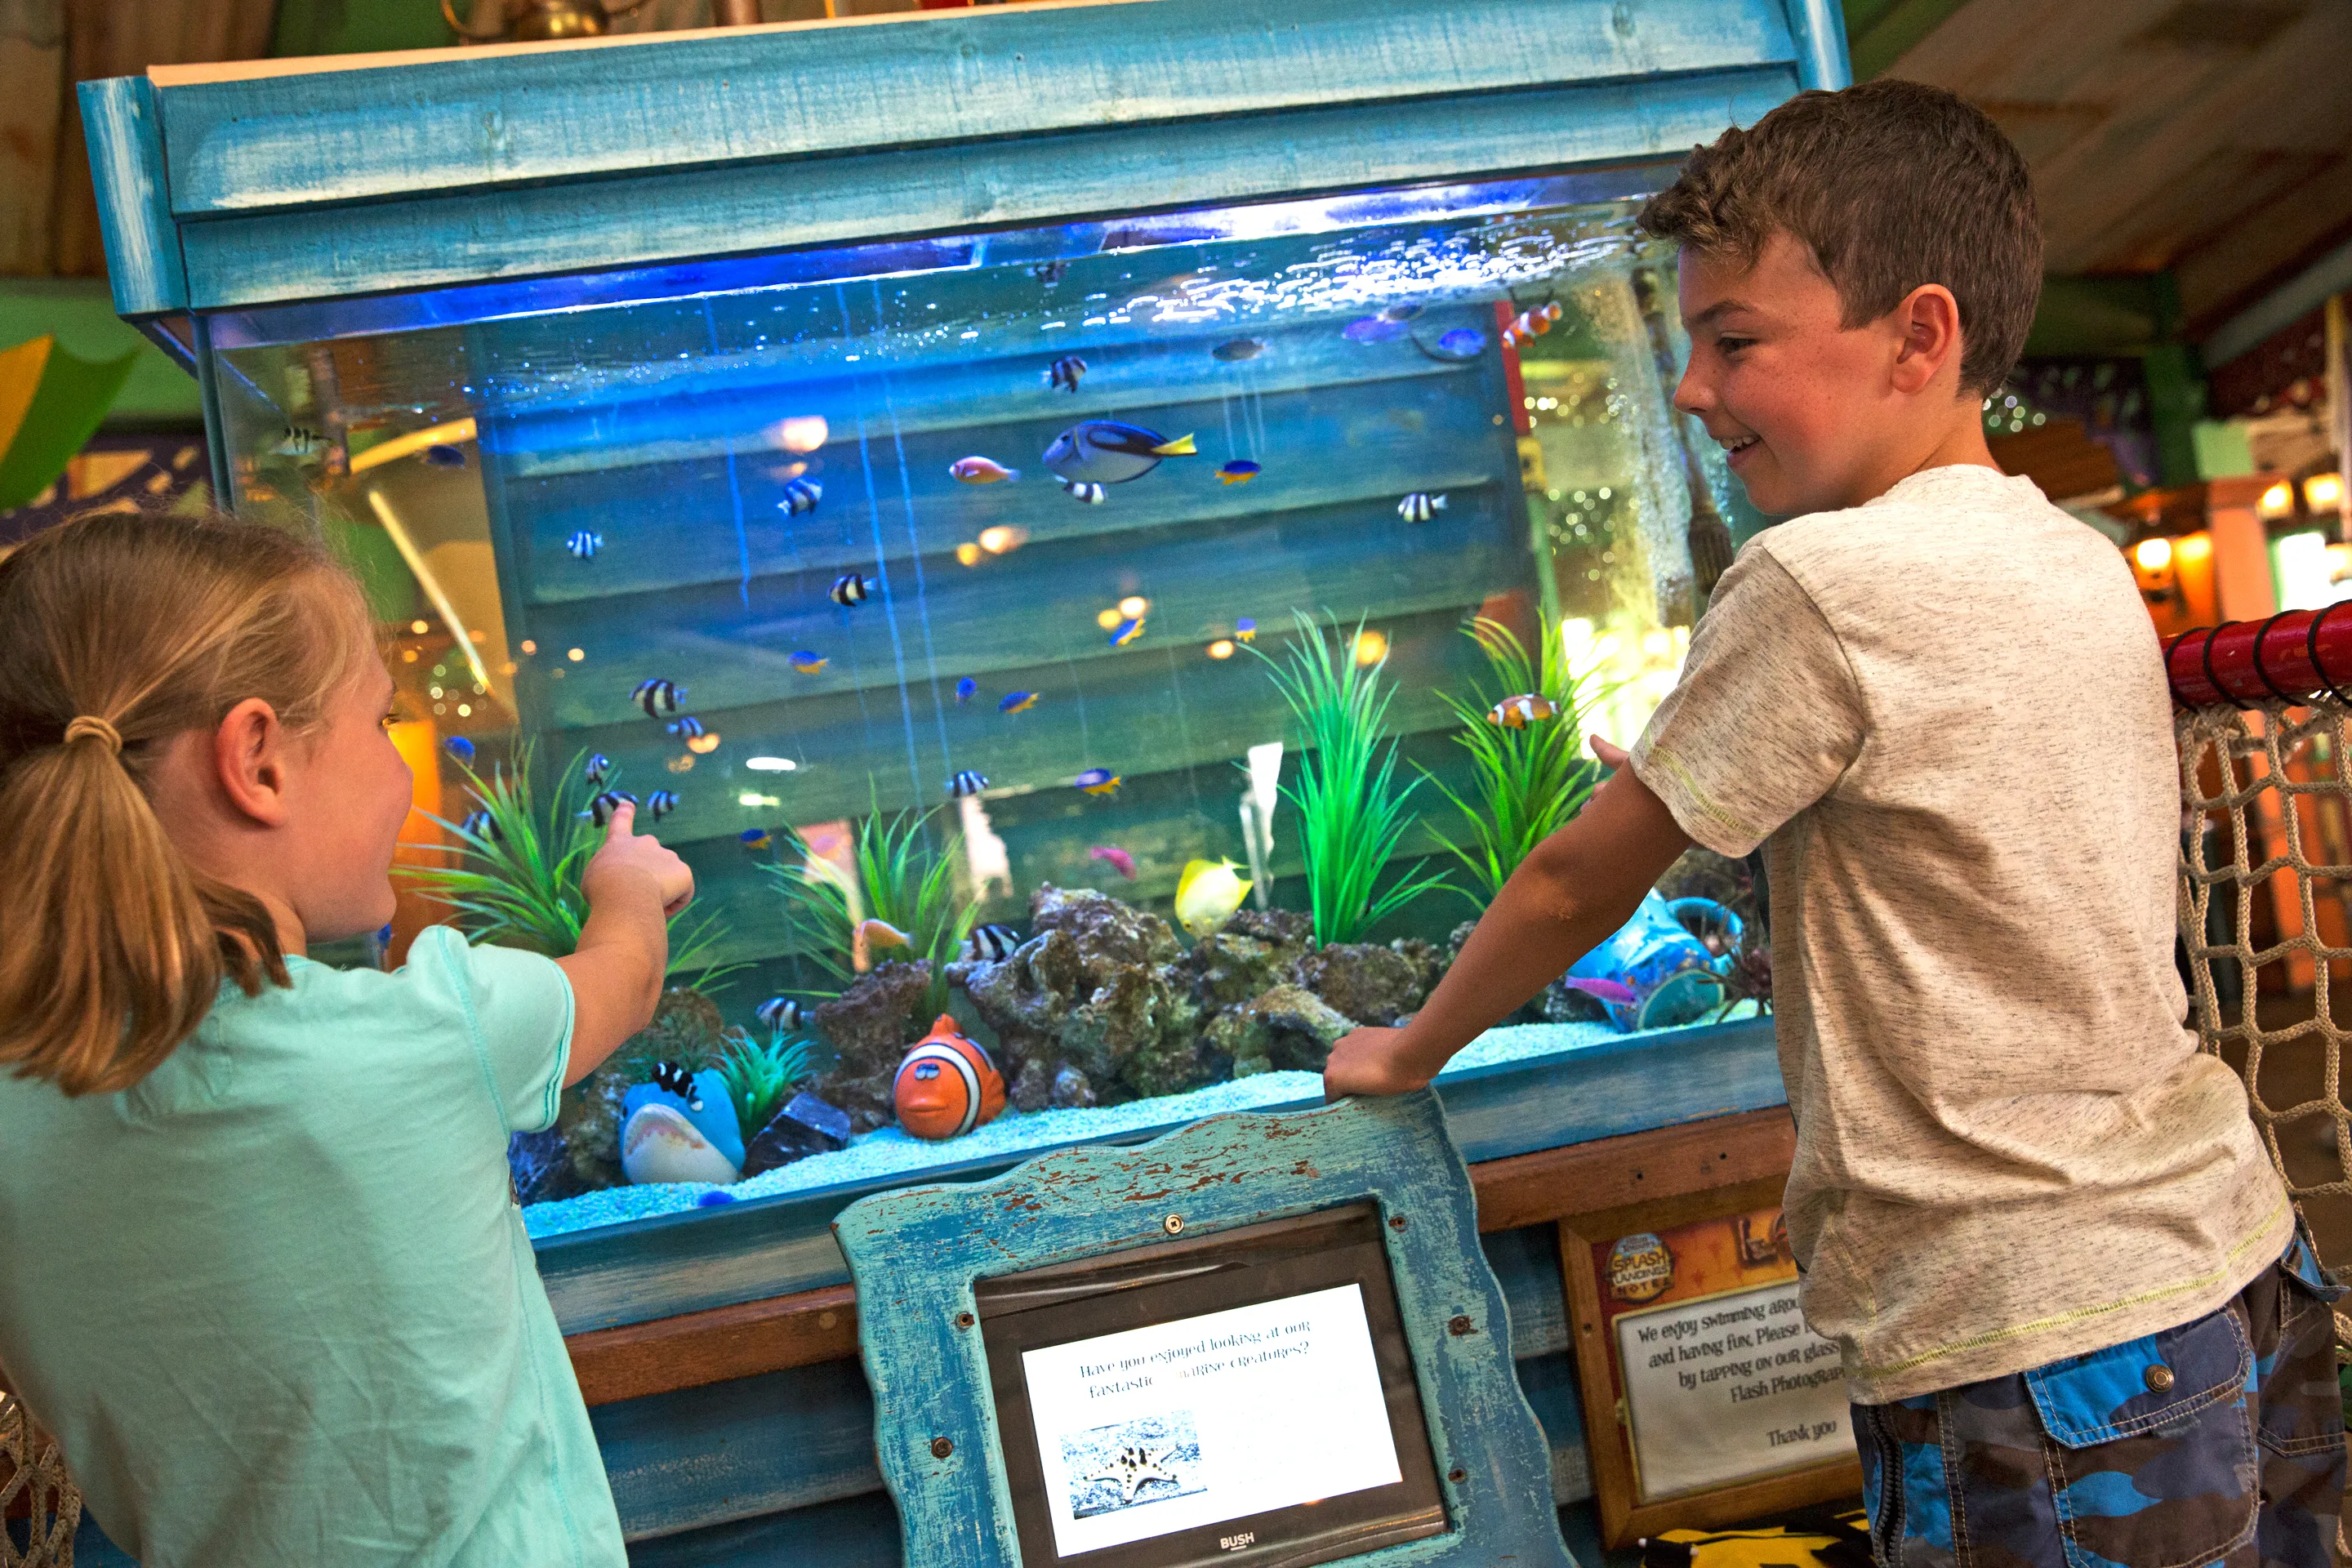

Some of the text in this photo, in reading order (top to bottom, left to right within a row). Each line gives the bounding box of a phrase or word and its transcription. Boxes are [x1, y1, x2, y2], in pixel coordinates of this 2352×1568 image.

[1613, 1252, 1667, 1272] SPLASH
[1638, 1326, 1658, 1343] We
[1661, 1320, 1698, 1340] enjoy
[1701, 1304, 1766, 1330] swimming
[1080, 1362, 1116, 1378] Have
[1120, 1356, 1146, 1372] you
[1150, 1340, 1206, 1364] enjoyed
[1209, 1332, 1262, 1351] looking
[1266, 1326, 1280, 1339] at
[1649, 1346, 1675, 1368] and
[1678, 1340, 1723, 1361] having
[1756, 1323, 1800, 1344] Please
[1089, 1376, 1154, 1398] fantastic
[1230, 1340, 1310, 1368] creatures?
[1678, 1371, 1697, 1390] by
[1700, 1360, 1752, 1383] tapping
[1755, 1356, 1773, 1370] on
[1803, 1342, 1840, 1363] glass
[1731, 1380, 1769, 1403] Flash
[1766, 1420, 1837, 1447] Thank you
[1220, 1532, 1254, 1549] BUSH
